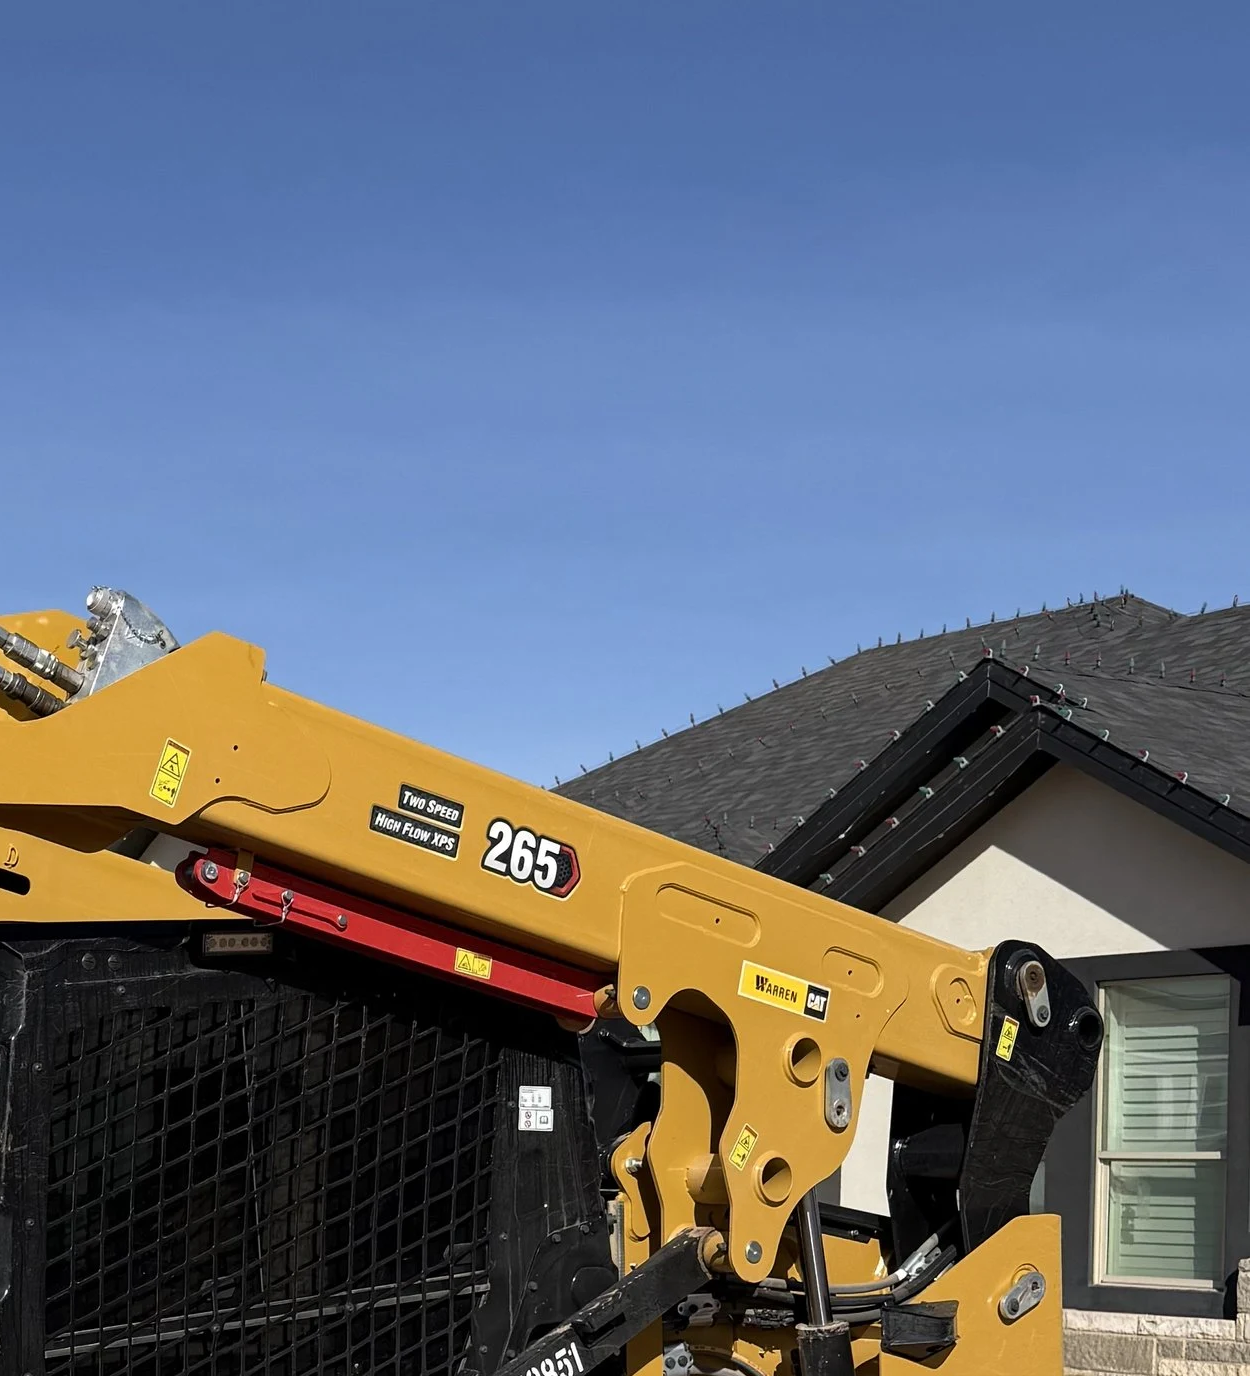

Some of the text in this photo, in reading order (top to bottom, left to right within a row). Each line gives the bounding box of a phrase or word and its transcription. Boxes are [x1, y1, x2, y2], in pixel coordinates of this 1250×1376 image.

[403, 790, 460, 822] TWO SPEED
[374, 812, 456, 852] HIGH FLOW XPS
[483, 820, 562, 889] 265
[755, 974, 798, 1003] WARREN
[806, 993, 827, 1012] CAT
